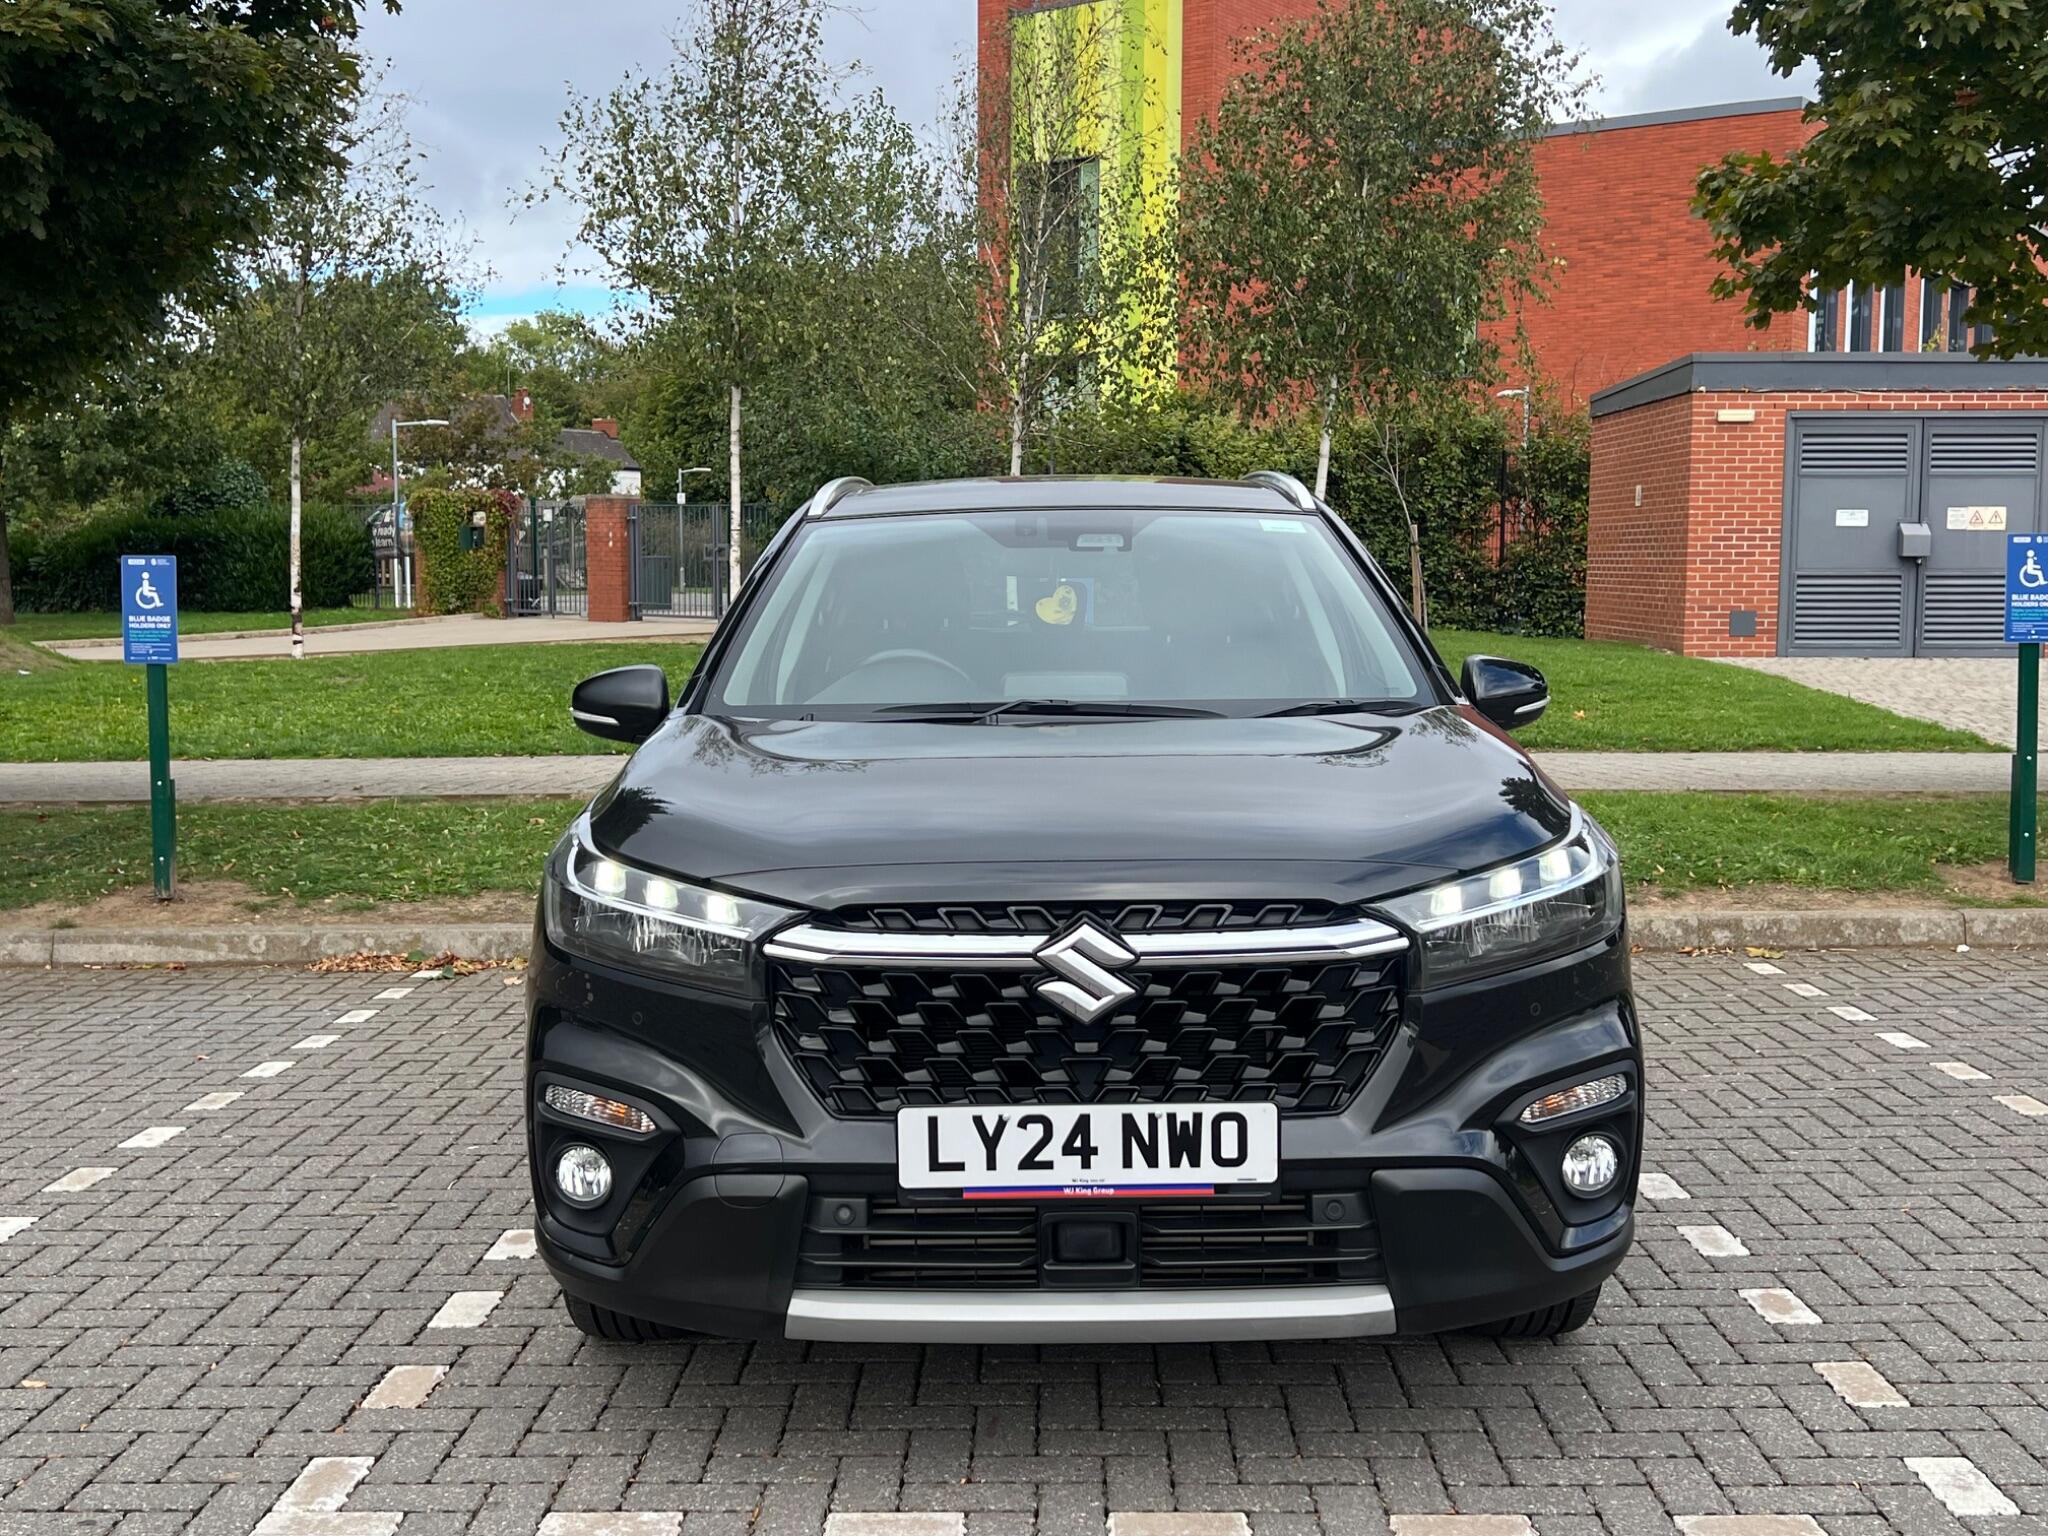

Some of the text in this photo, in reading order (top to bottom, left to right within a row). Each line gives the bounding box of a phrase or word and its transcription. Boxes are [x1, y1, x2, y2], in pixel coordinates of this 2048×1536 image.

[2011, 593, 2048, 601] BLUE BADG
[927, 1111, 1248, 1172] LY24 NWO
[1075, 1187, 1092, 1196] King
[1092, 1186, 1114, 1195] Group
